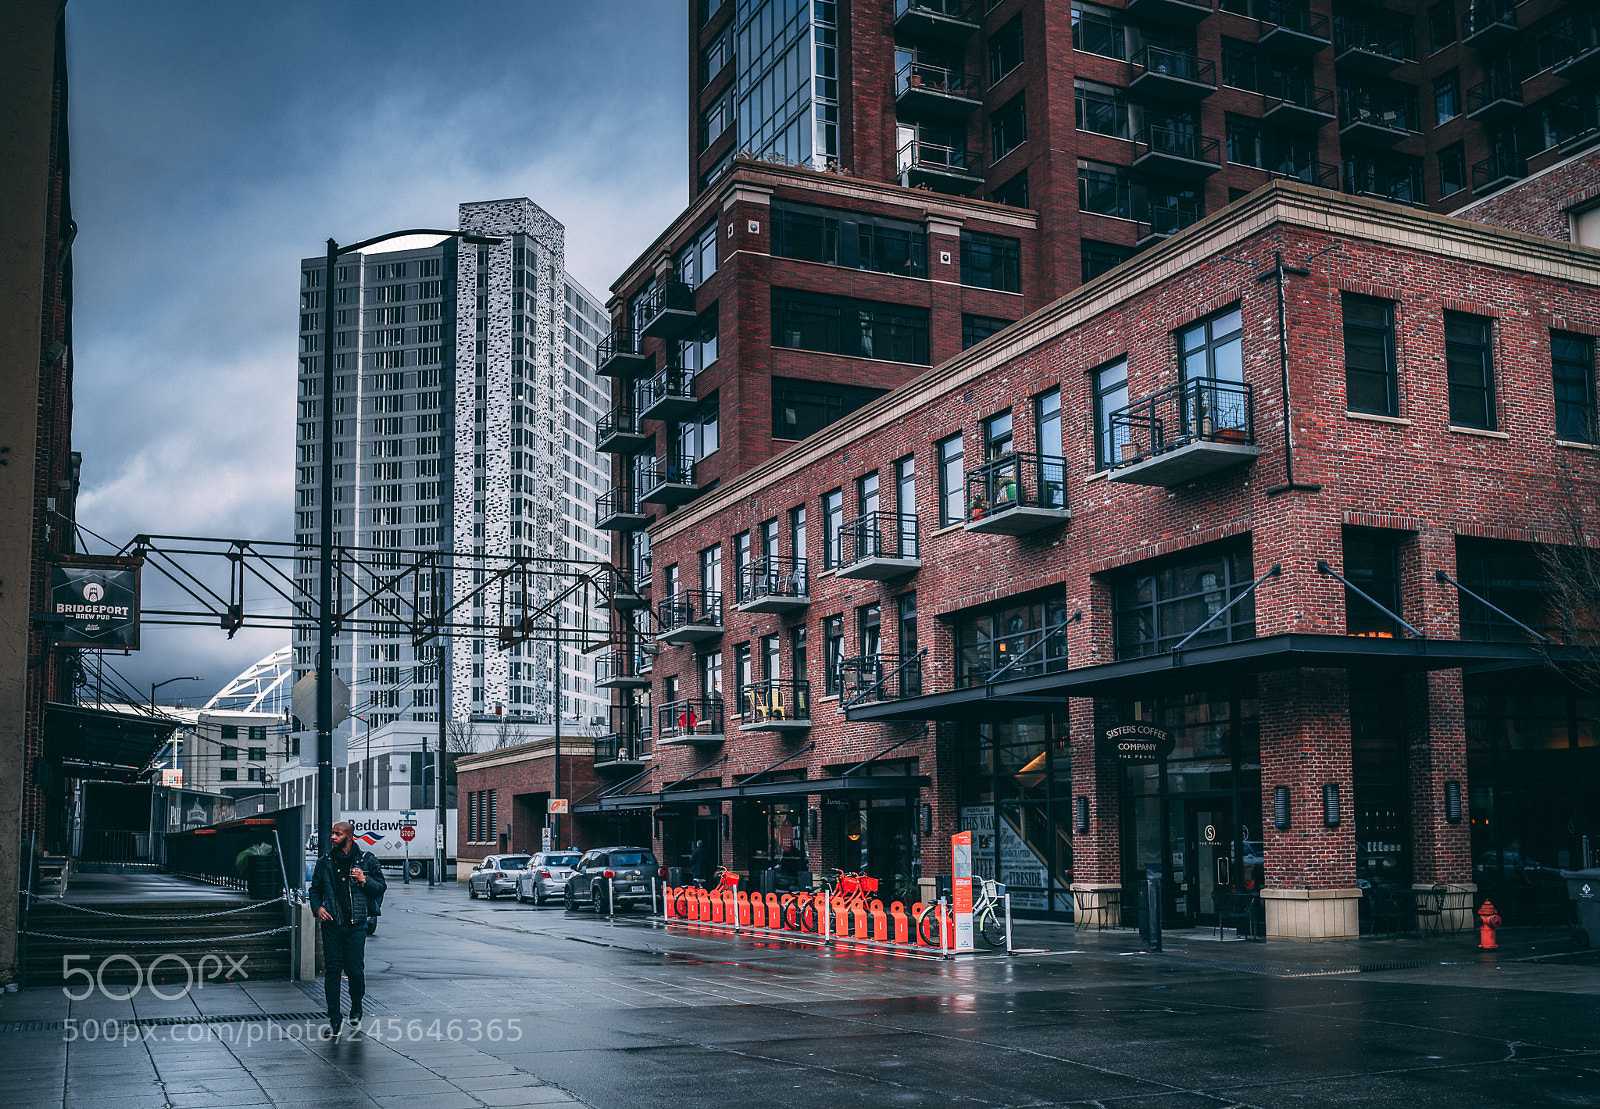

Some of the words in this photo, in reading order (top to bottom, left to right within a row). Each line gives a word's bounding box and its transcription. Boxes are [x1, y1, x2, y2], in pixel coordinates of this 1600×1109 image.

[56, 603, 129, 616] BRIDGEPORT
[1106, 726, 1136, 739] SISTERS
[1138, 726, 1167, 740] COFFEE
[1117, 742, 1157, 751] COMPANY
[962, 816, 978, 830] THIS
[1008, 871, 1042, 887] FIRESIDE
